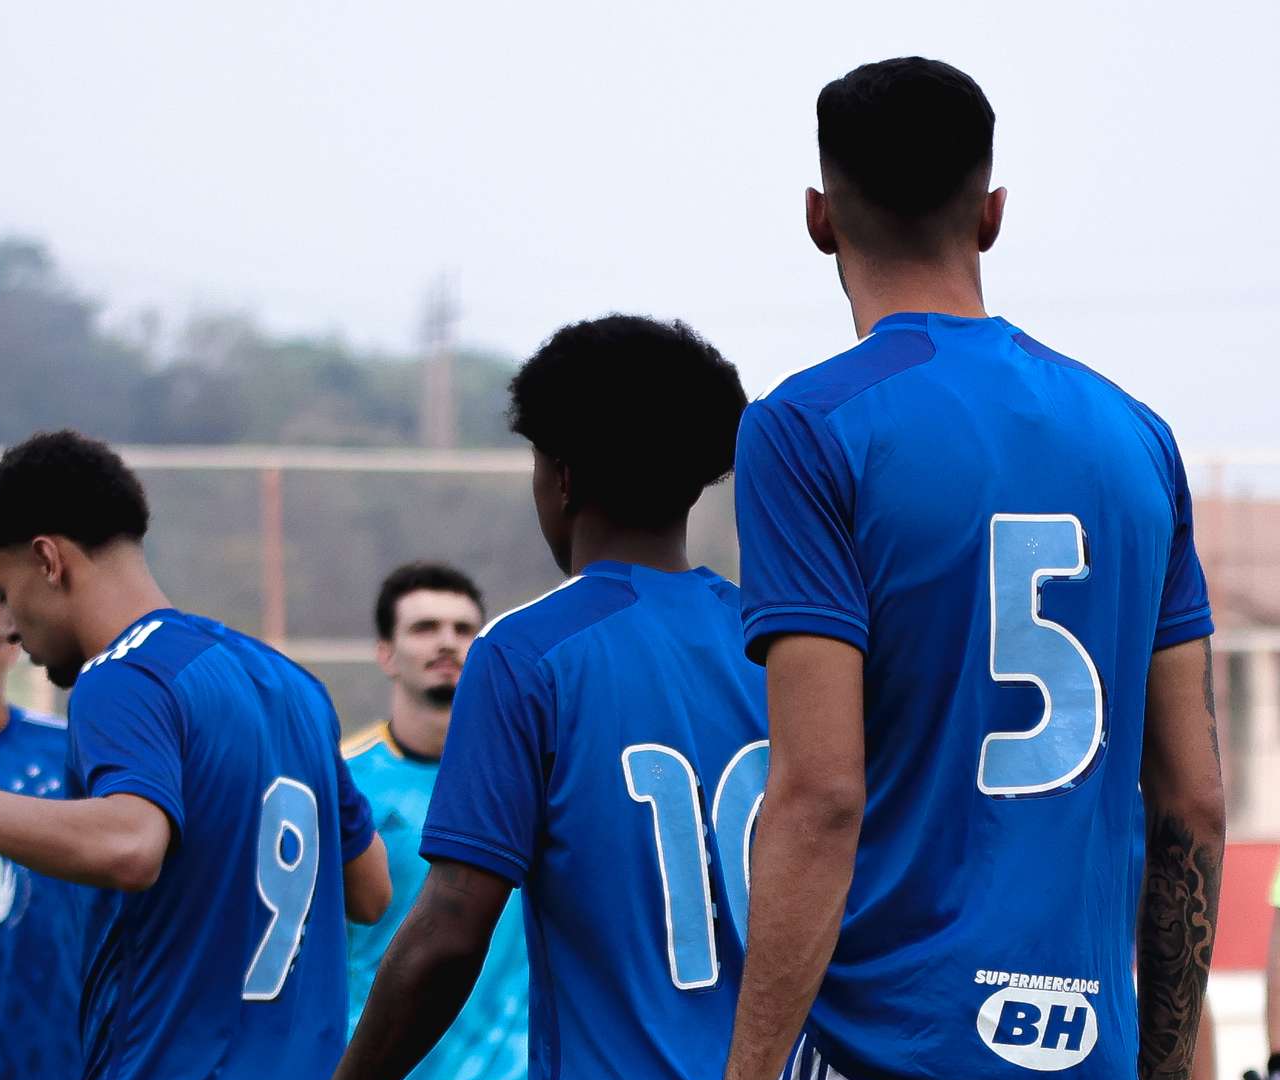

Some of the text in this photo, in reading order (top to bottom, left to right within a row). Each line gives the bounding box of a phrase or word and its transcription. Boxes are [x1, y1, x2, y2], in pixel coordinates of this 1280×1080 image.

[977, 512, 1106, 797] 5
[241, 777, 319, 1000] 9
[974, 969, 1100, 994] SUPERMERCADOS
[992, 1000, 1088, 1051] BH
